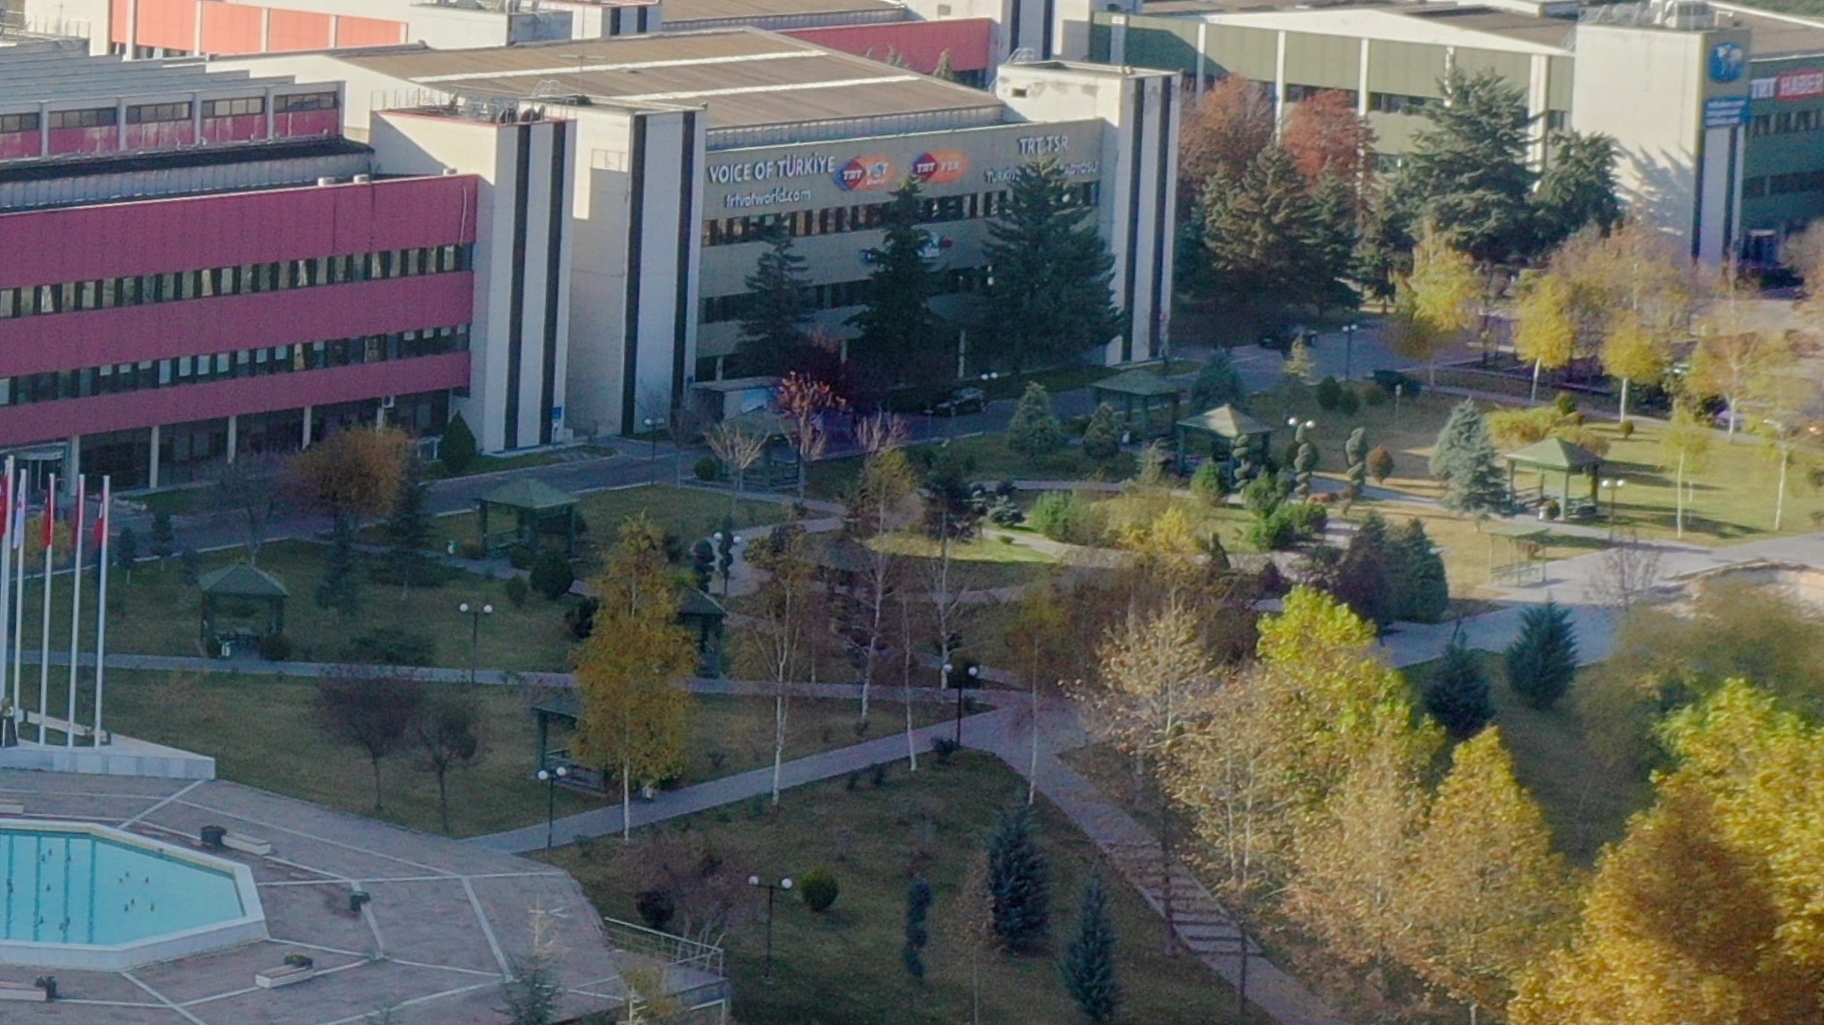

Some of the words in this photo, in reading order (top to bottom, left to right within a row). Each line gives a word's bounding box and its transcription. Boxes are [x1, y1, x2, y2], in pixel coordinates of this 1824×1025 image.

[1780, 73, 1824, 96] HABER
[1020, 137, 1042, 154] TRT
[709, 164, 751, 183] VOICE
[754, 160, 773, 179] OF
[777, 152, 836, 177] TÜRKİYE
